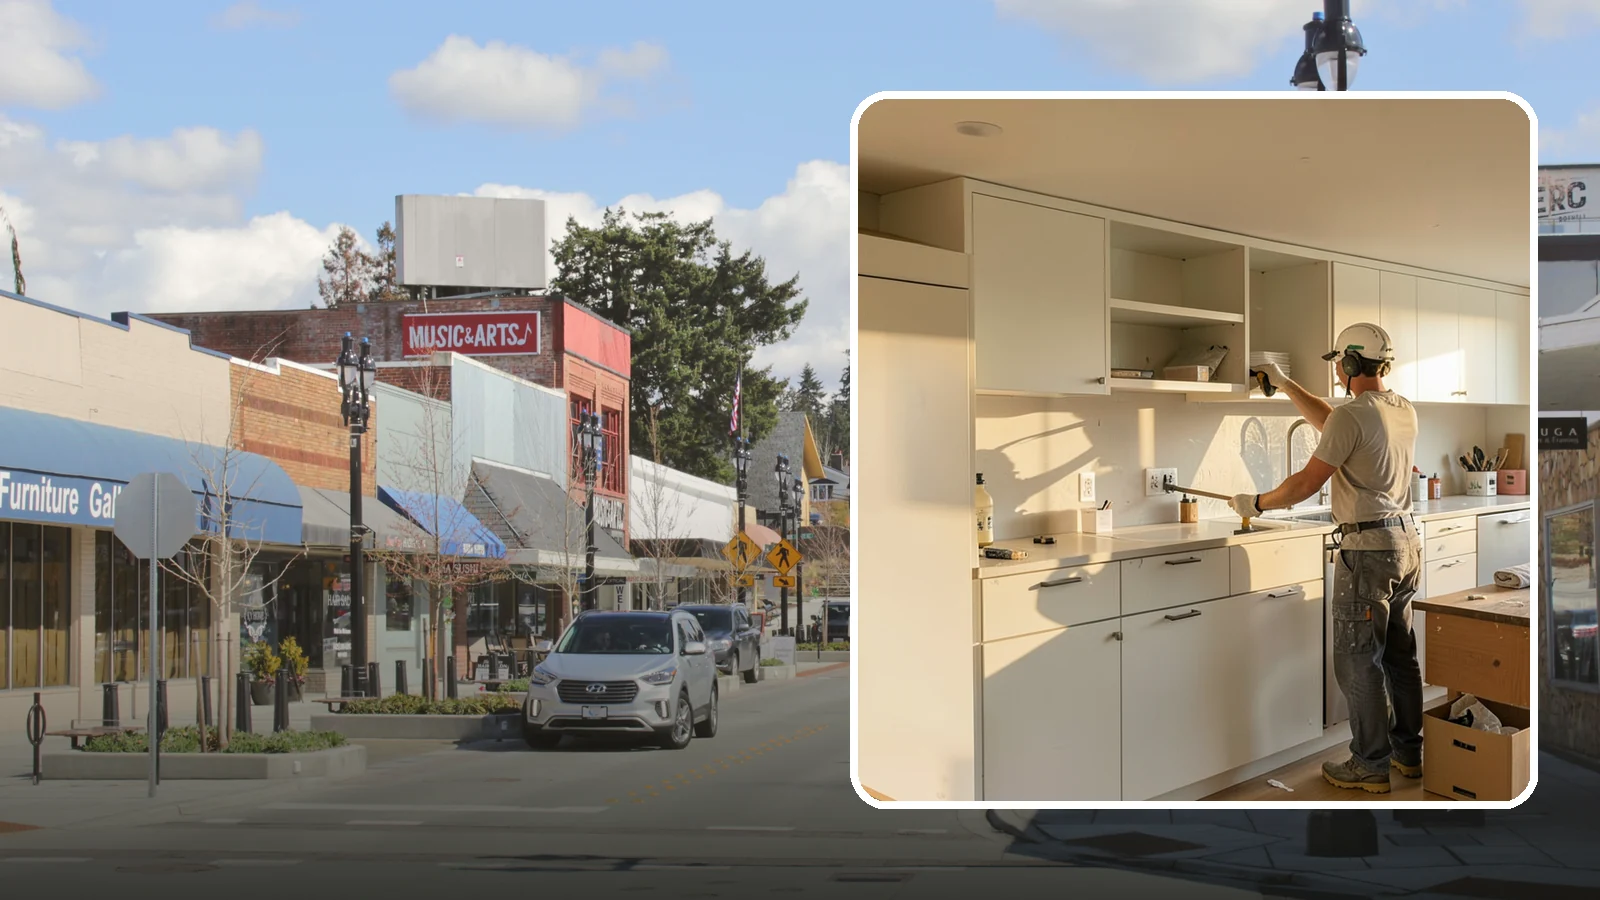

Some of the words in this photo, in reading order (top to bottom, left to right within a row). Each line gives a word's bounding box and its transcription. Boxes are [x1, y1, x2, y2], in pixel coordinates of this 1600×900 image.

[409, 323, 519, 348] MUSIC&ARTS
[1540, 428, 1577, 436] UGA
[0, 472, 79, 515] Furniture
[90, 482, 121, 519] Gal
[454, 563, 479, 574] SUSHI
